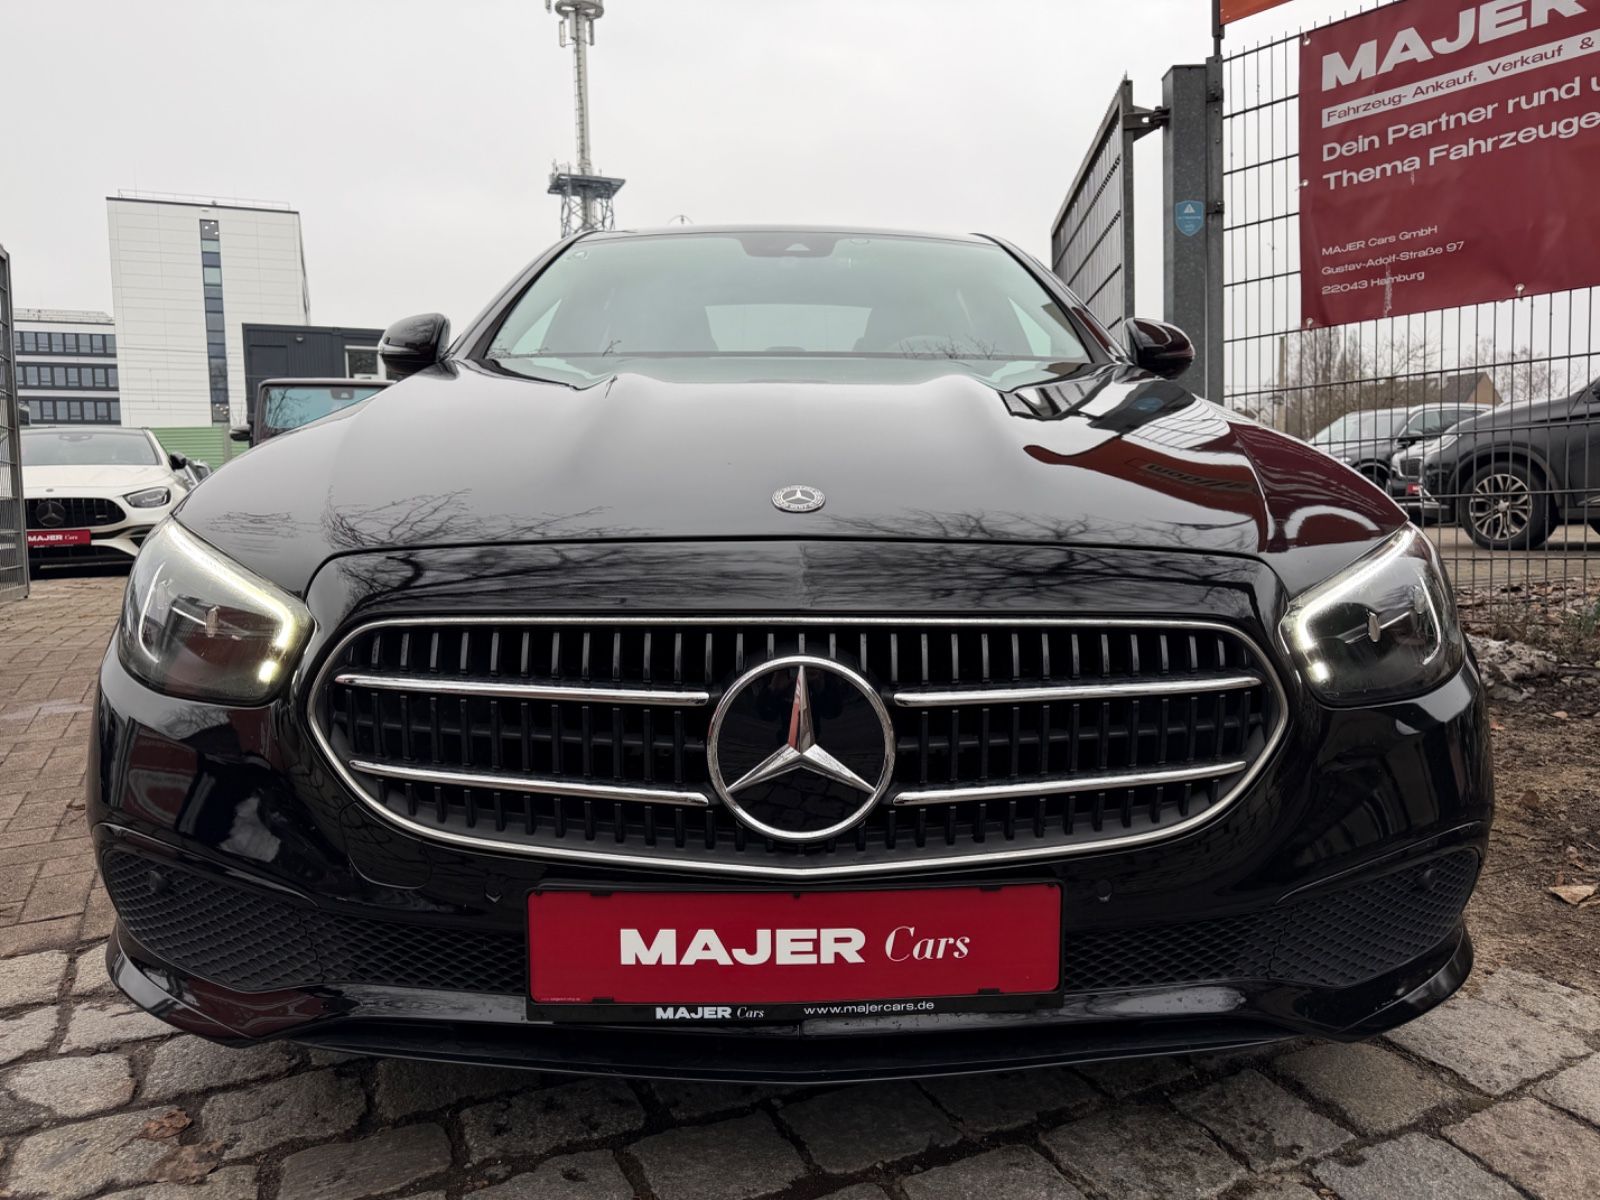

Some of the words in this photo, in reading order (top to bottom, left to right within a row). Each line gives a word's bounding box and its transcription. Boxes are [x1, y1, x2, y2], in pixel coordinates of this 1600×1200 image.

[1322, 0, 1587, 92] MAJER
[1488, 45, 1563, 75] Verkauf
[1580, 37, 1594, 50] &
[1322, 135, 1380, 162] Dein
[1388, 103, 1498, 145] Partner
[1507, 76, 1580, 114] rund
[1322, 156, 1420, 190] Thema
[1429, 112, 1600, 166] Fahrzeuge
[1322, 241, 1366, 256] MAJER
[1368, 235, 1396, 247] Cars
[1399, 225, 1438, 241] GmbH
[1322, 247, 1443, 275] Gustav-Adolf-Straße
[1446, 241, 1465, 253] 97
[1322, 279, 1368, 295] 22043
[1371, 271, 1425, 287] Hamburg
[28, 534, 63, 542] MAJER
[620, 928, 866, 966] MAJER
[885, 925, 970, 962] Cars
[655, 1006, 732, 1020] MAJER
[736, 1006, 764, 1018] Cars
[803, 1000, 935, 1015] www.majercars.de
